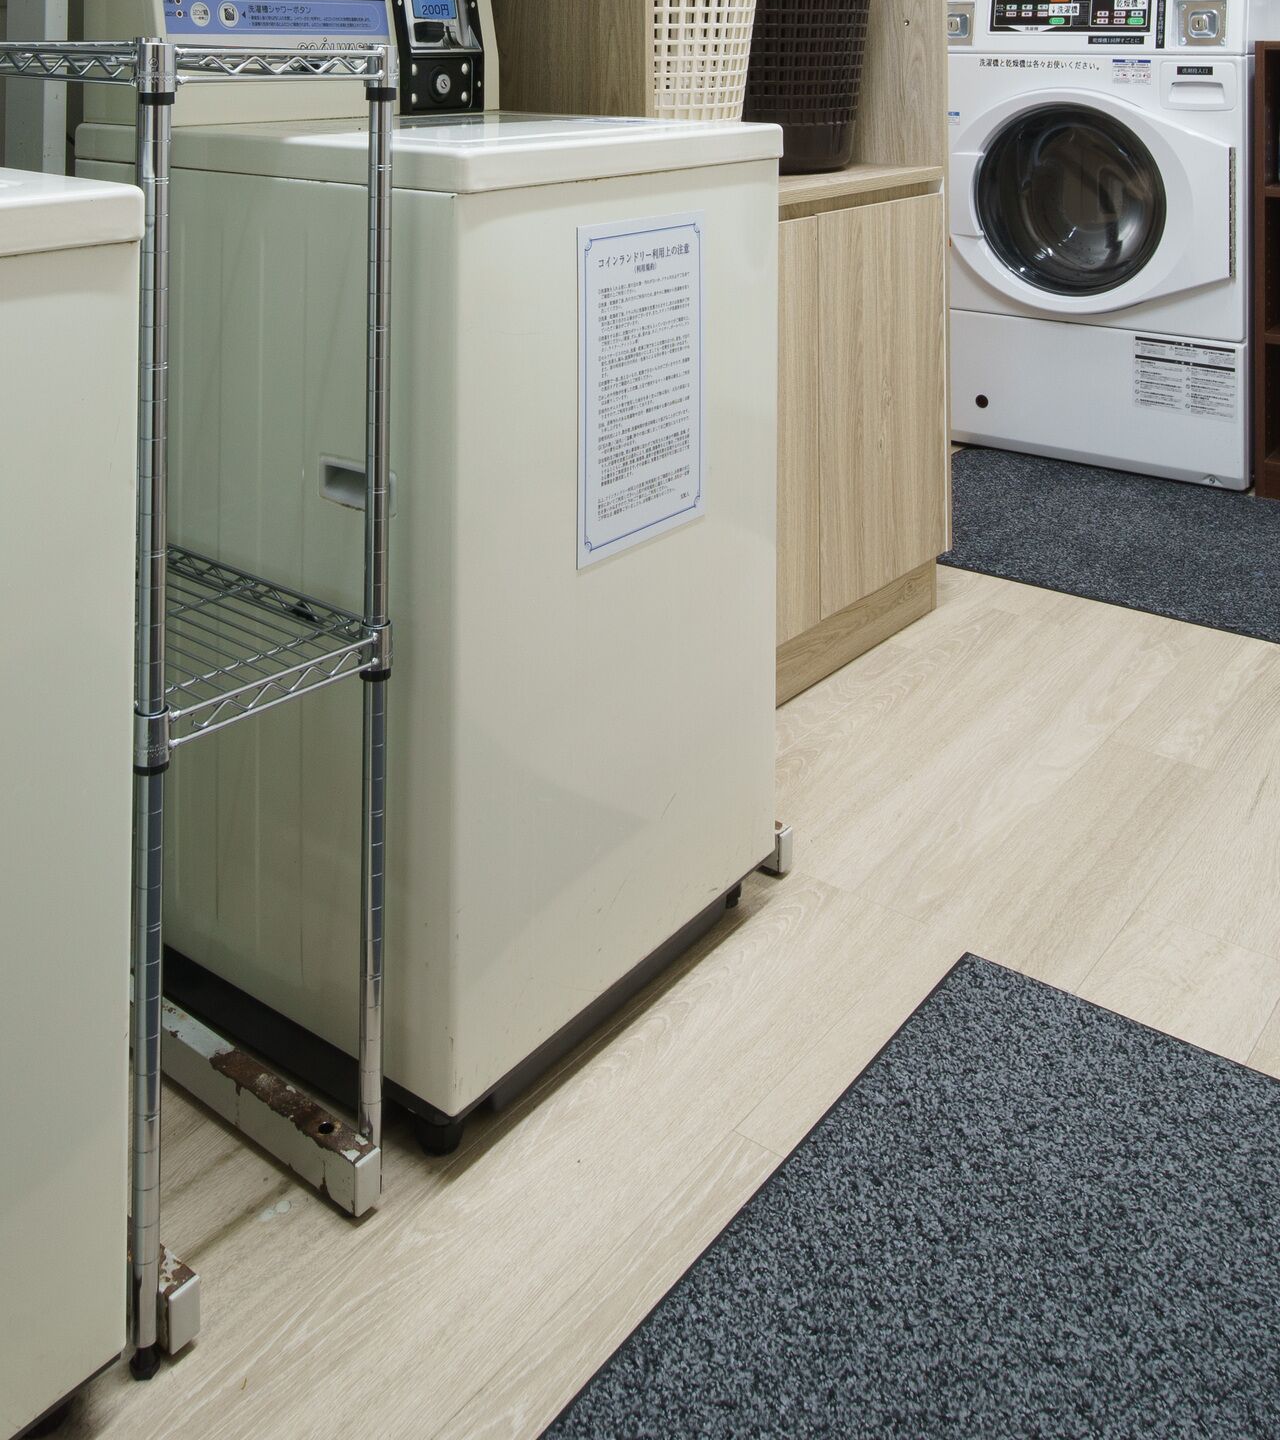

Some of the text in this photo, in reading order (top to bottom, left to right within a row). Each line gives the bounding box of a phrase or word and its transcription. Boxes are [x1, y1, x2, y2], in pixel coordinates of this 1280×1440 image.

[422, 3, 450, 17] 200円
[1056, 5, 1079, 14] 洗濯機
[1116, 0, 1138, 8] 乾燥機
[979, 59, 1100, 71] 洗濯機と乾燥機は各々お使いください。
[598, 243, 690, 269] コインランドリー利用上の注意
